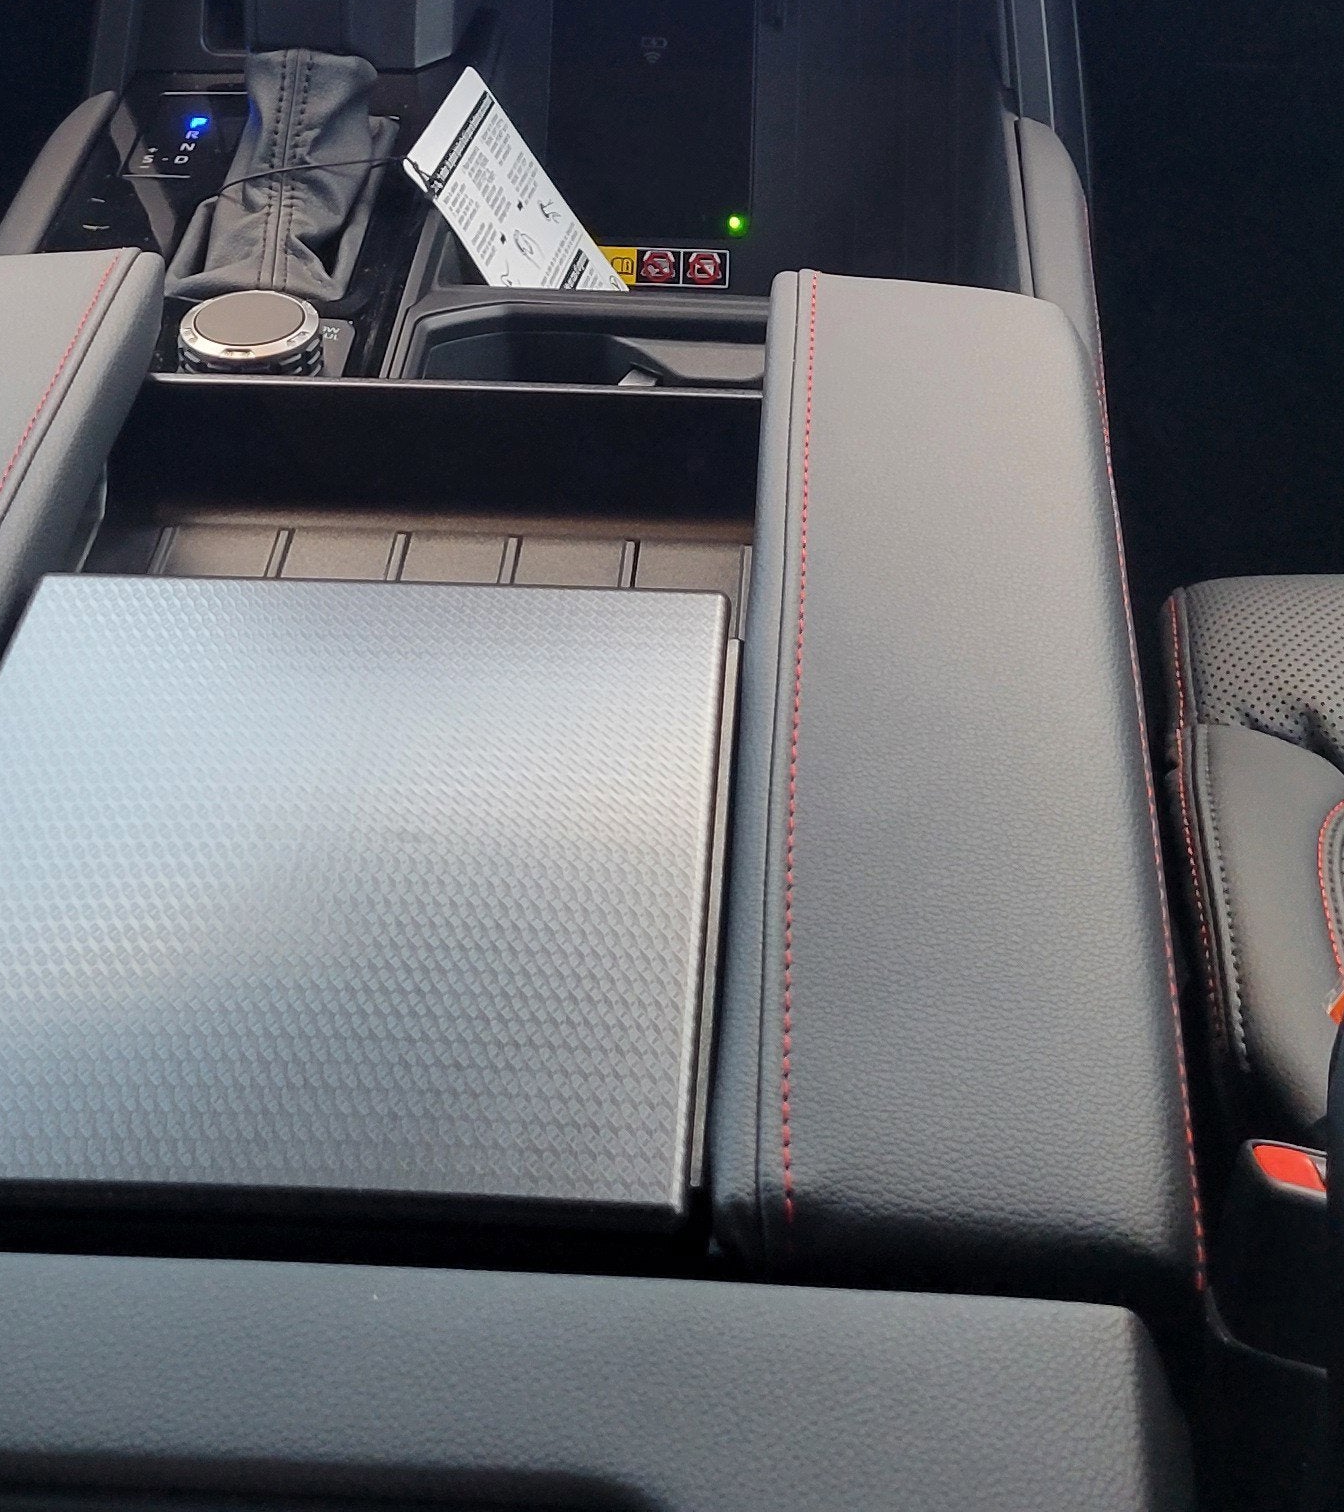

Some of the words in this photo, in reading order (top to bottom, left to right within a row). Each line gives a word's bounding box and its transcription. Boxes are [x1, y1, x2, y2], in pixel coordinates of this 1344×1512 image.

[185, 130, 200, 140] R
[179, 142, 196, 152] N
[141, 154, 154, 164] S
[173, 155, 189, 165] D
